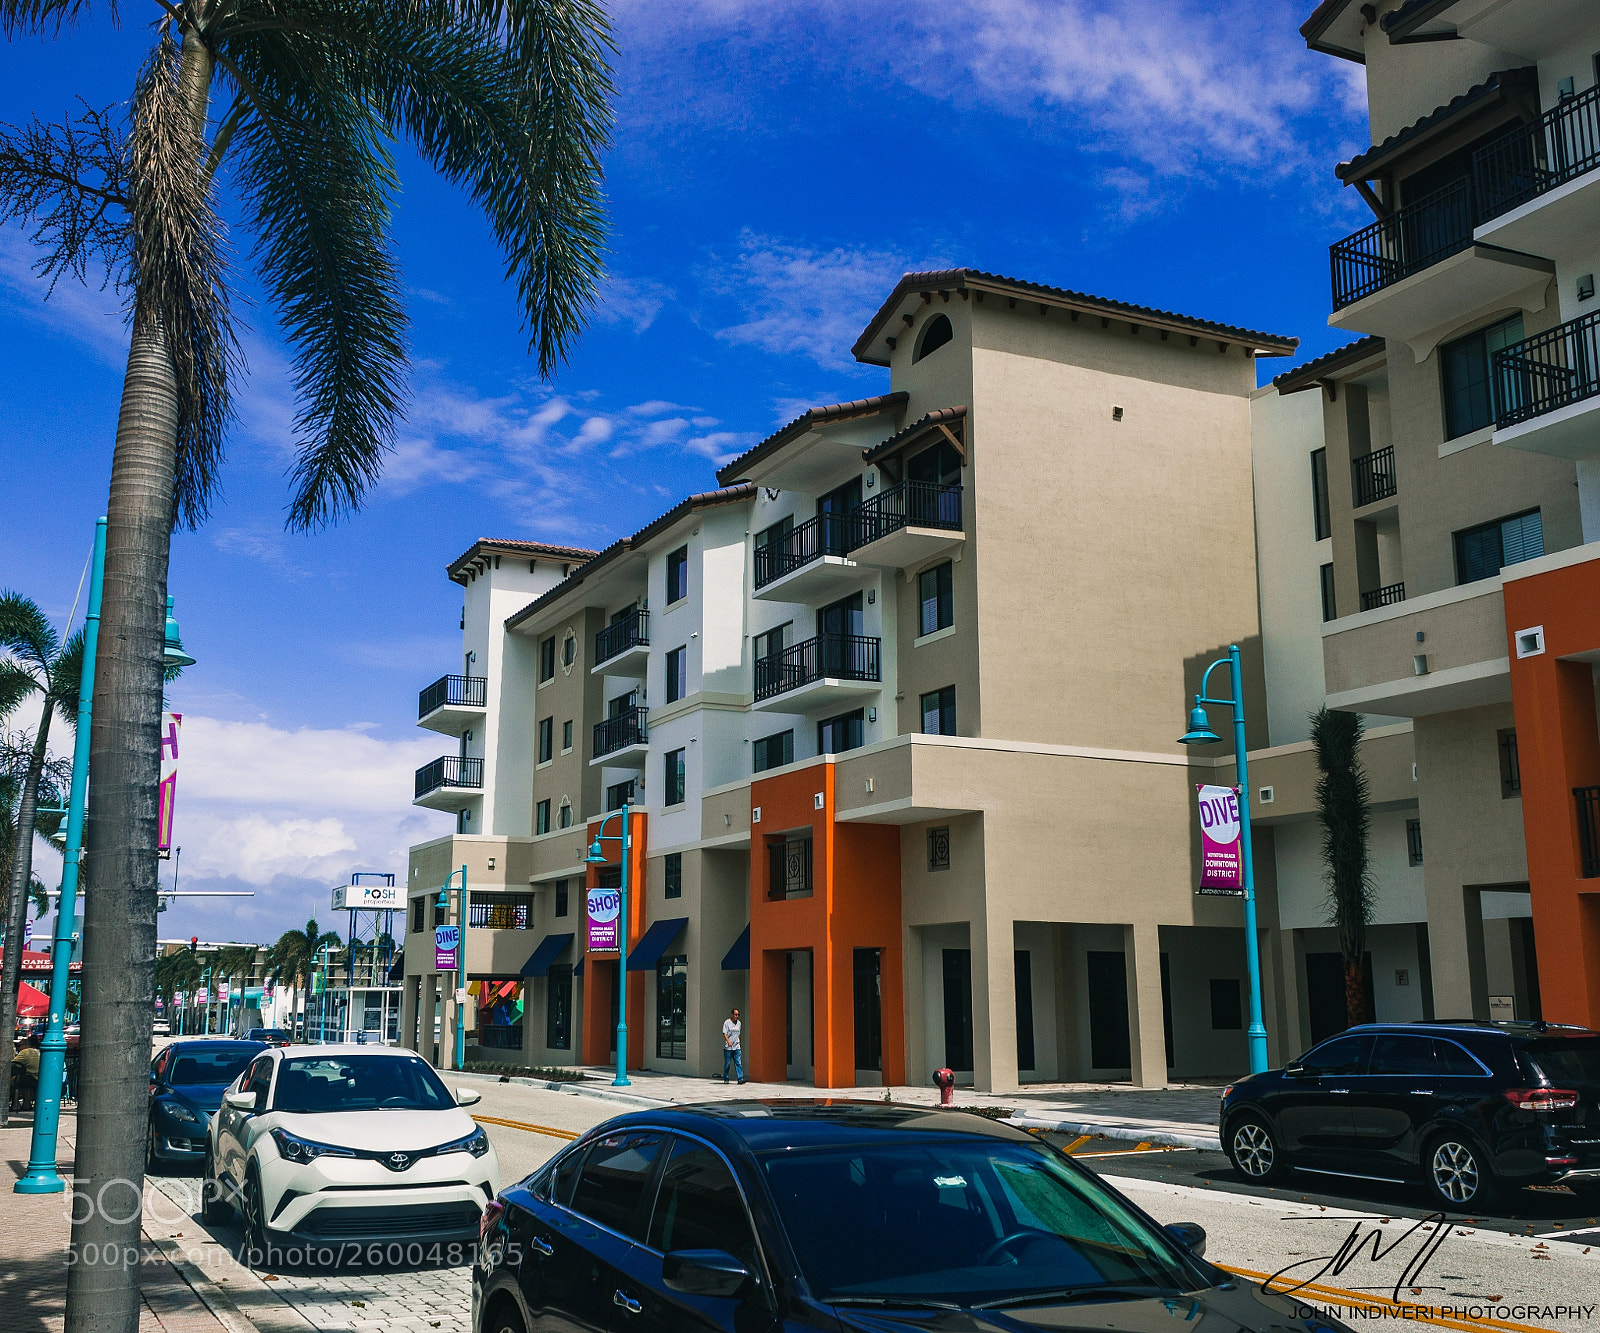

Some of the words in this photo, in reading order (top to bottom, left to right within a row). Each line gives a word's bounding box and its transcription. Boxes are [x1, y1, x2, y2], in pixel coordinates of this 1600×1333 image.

[1199, 796, 1240, 828] DIVE
[1205, 860, 1238, 868] DOWNTOWN
[1206, 869, 1236, 878] DISTRICT
[364, 889, 396, 899] POSH
[588, 894, 620, 913] SHOP
[436, 929, 460, 944] DINE
